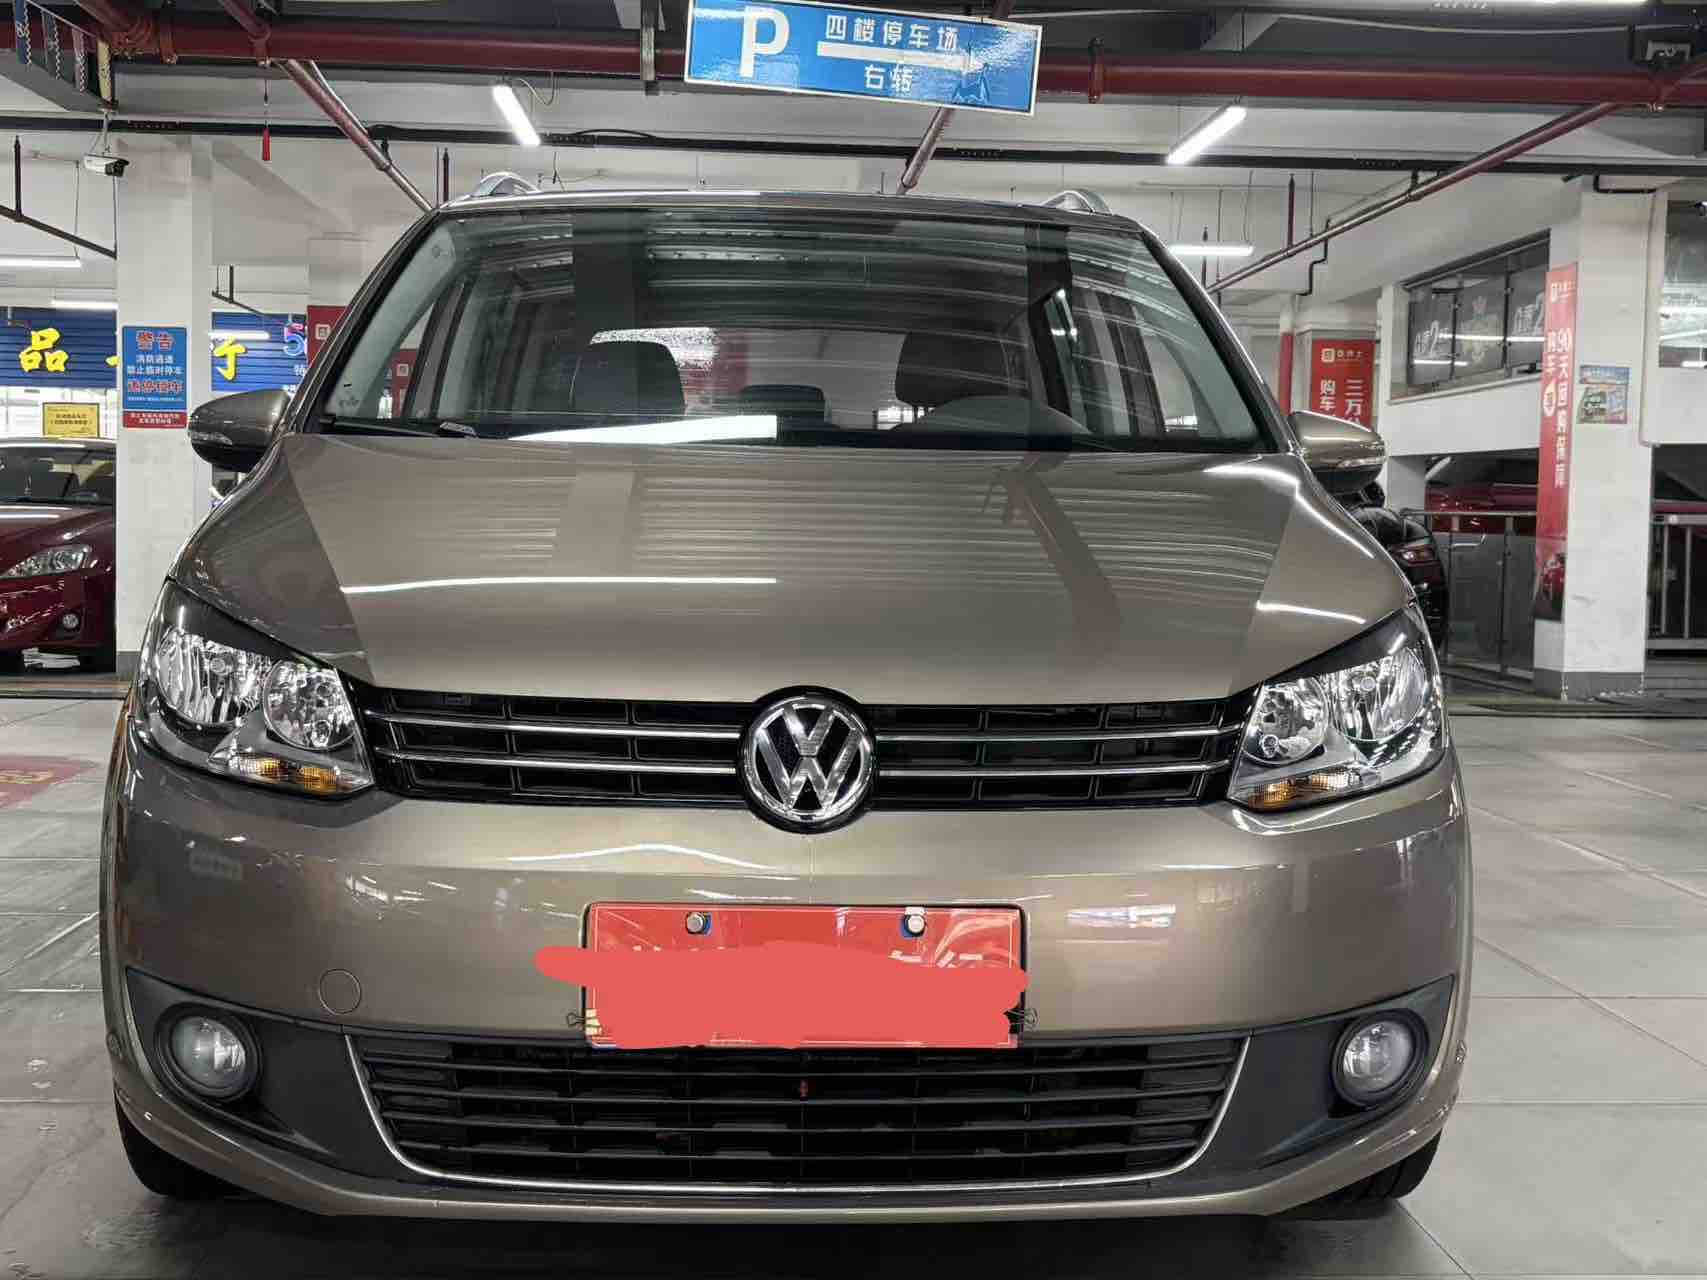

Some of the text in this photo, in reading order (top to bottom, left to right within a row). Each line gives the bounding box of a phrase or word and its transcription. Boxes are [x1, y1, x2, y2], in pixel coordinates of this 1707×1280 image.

[740, 8, 790, 78] P
[826, 15, 960, 50] 四楼停车场
[865, 64, 913, 92] 右转
[20, 328, 68, 372] 品
[1320, 379, 1336, 411] 购车
[1344, 379, 1363, 422] 三万
